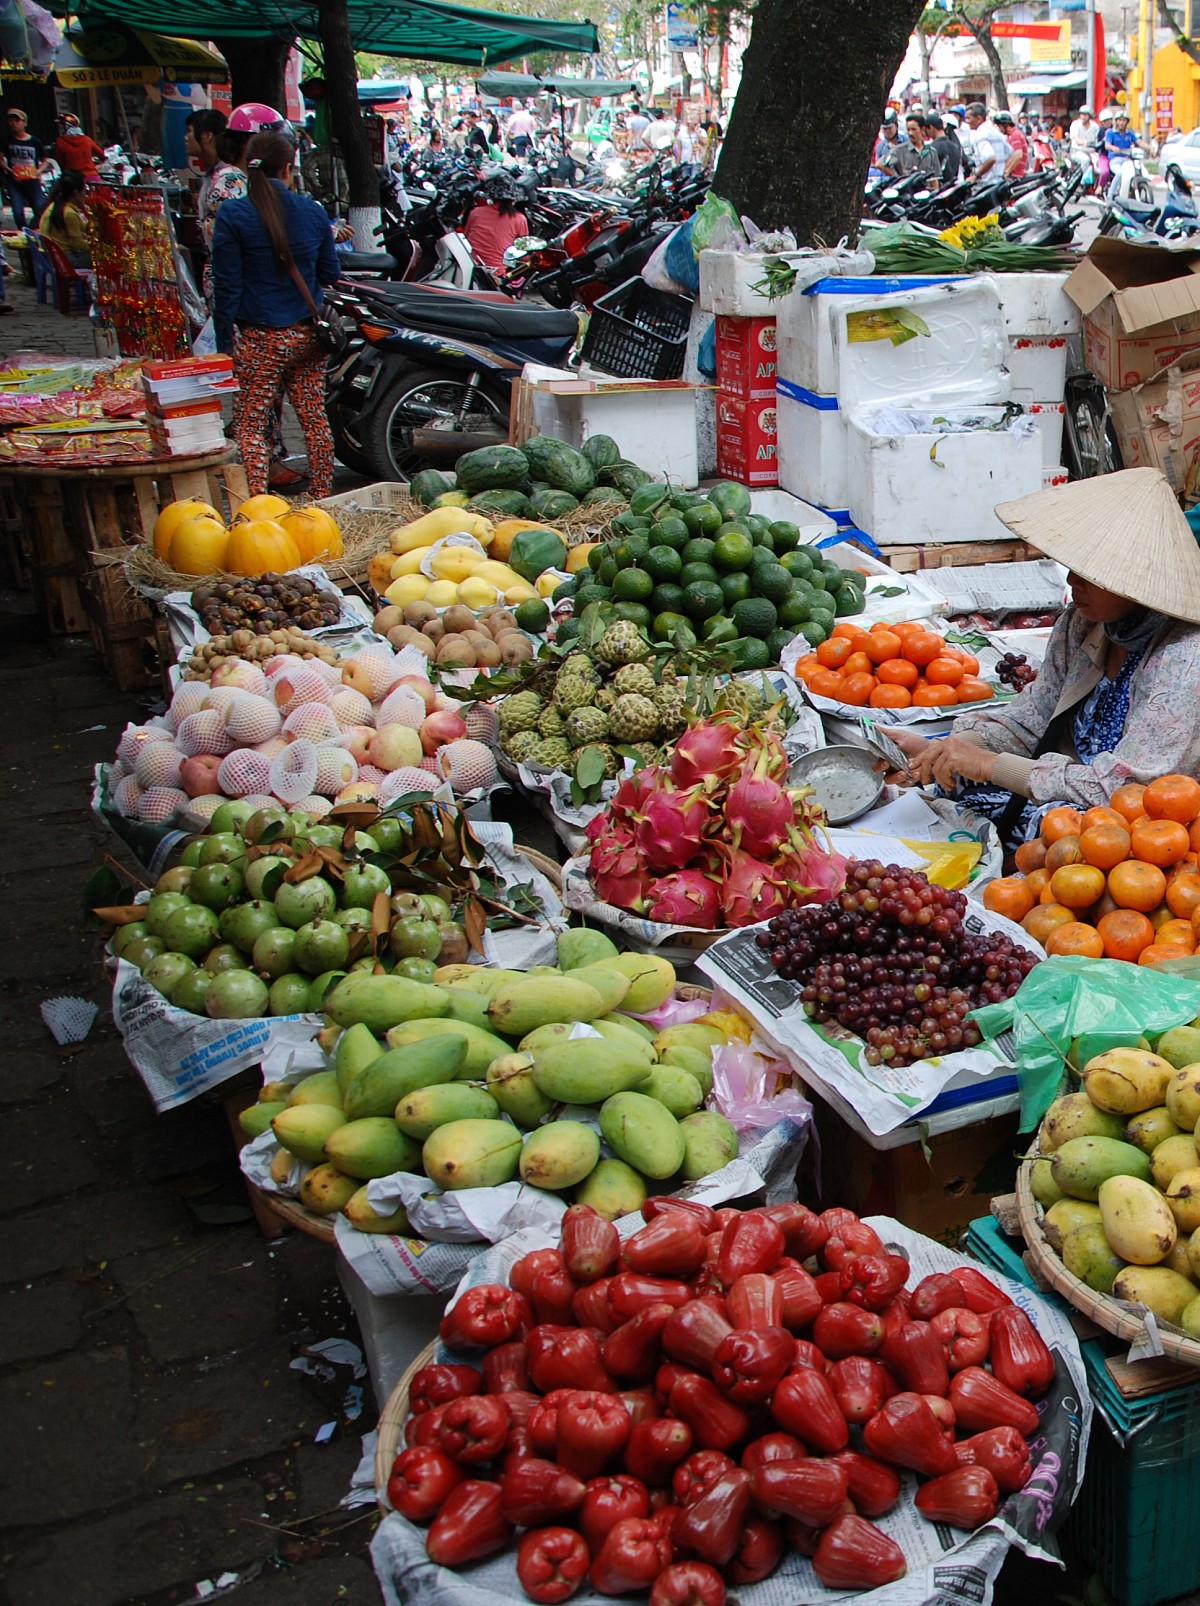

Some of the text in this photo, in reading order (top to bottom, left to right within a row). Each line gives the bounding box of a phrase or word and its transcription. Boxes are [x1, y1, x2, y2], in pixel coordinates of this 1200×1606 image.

[89, 71, 97, 81] 2
[755, 362, 778, 378] AP
[755, 444, 778, 460] AP
